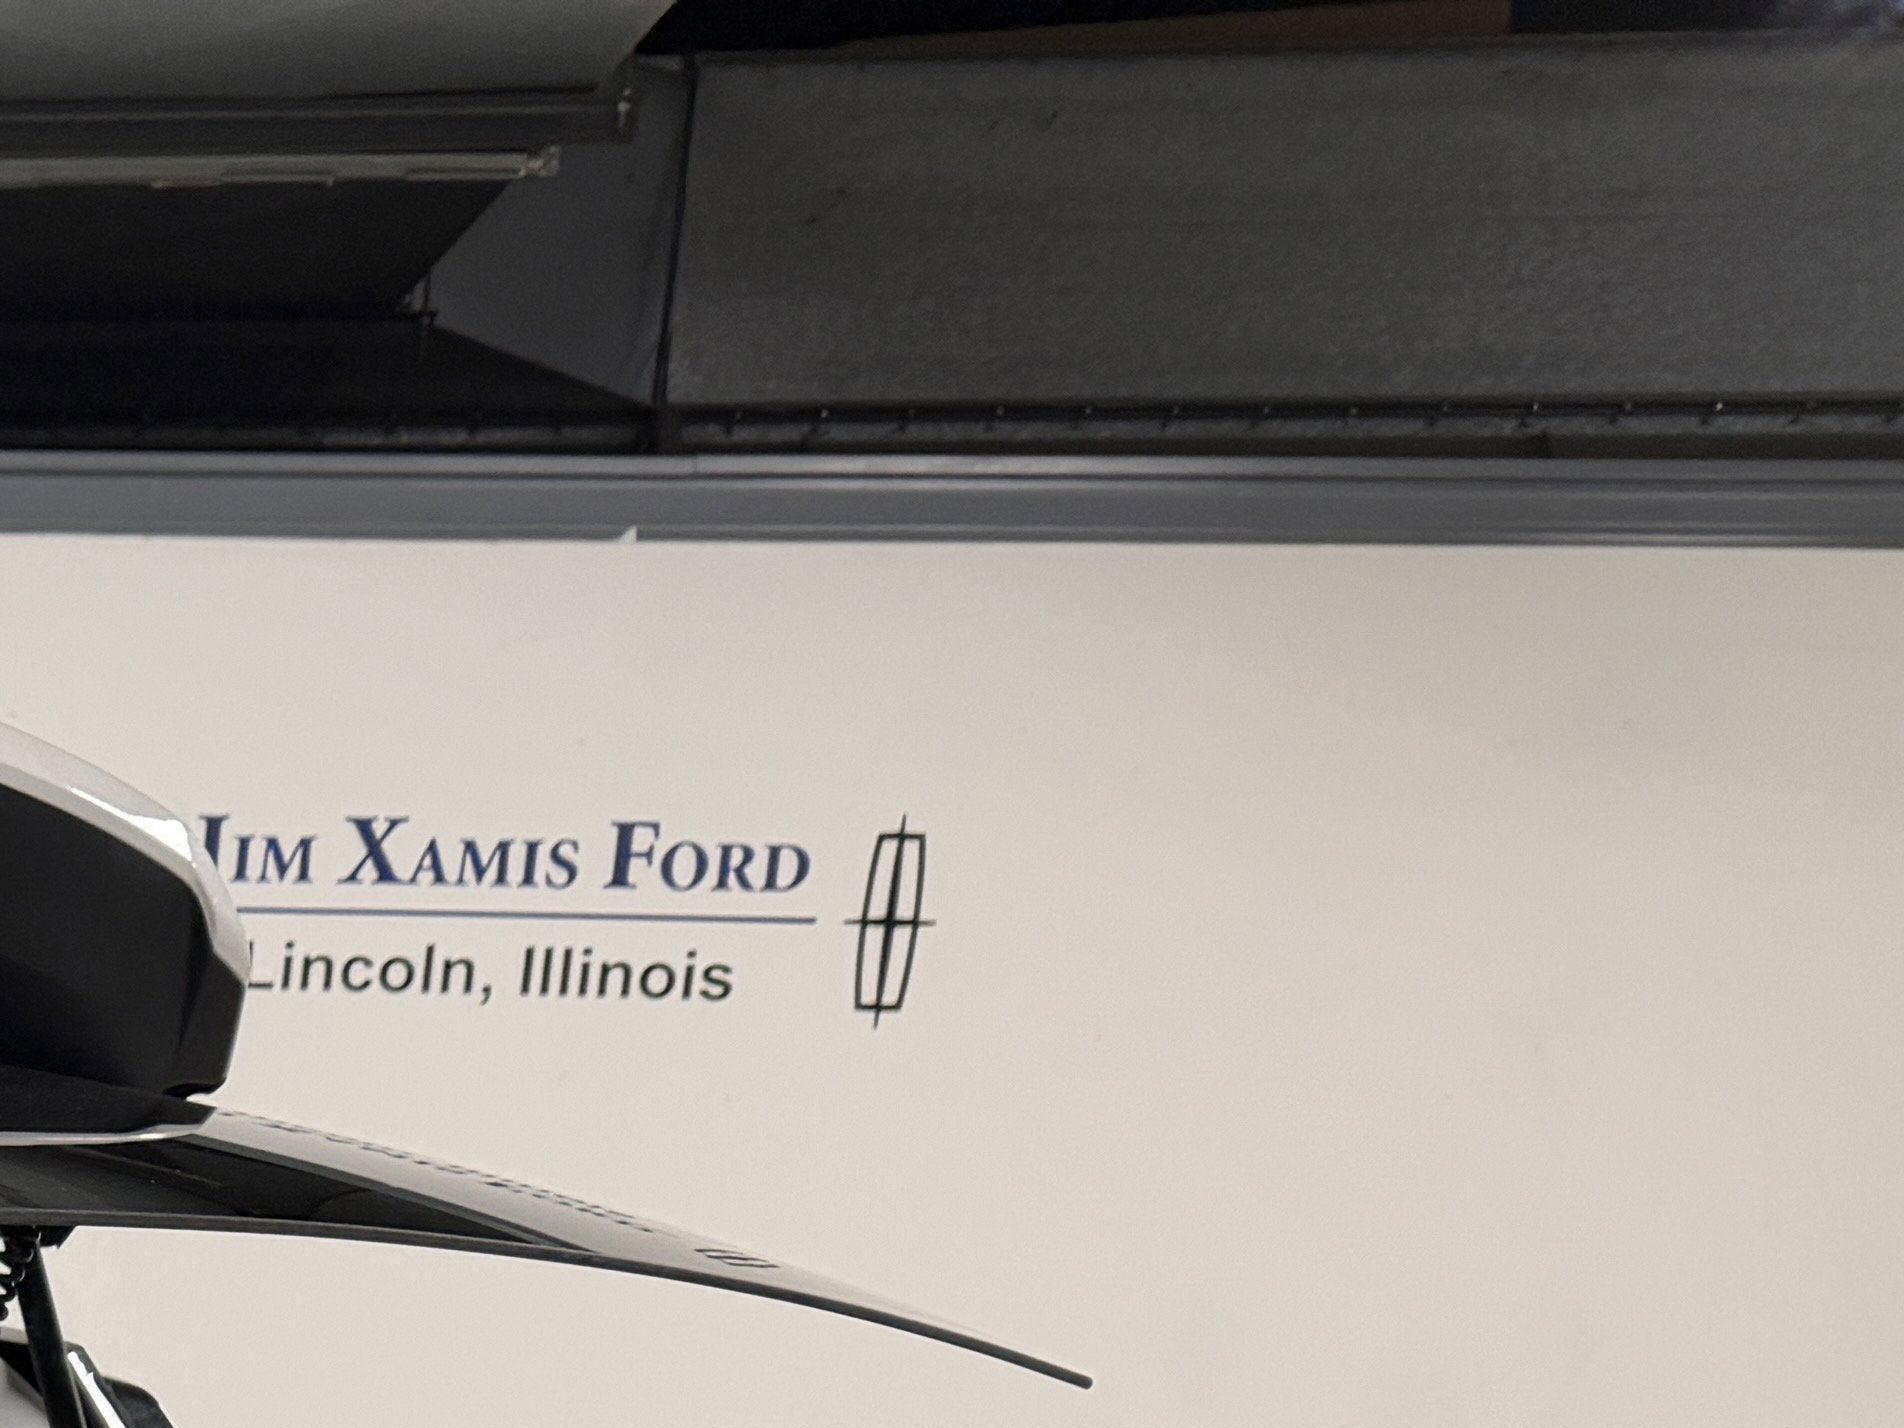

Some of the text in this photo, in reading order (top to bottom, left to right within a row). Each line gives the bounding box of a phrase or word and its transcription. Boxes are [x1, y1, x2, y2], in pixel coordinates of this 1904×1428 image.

[198, 814, 811, 893] JIM XAMIS FORD
[249, 940, 734, 1005] Lincoln, Illinois
